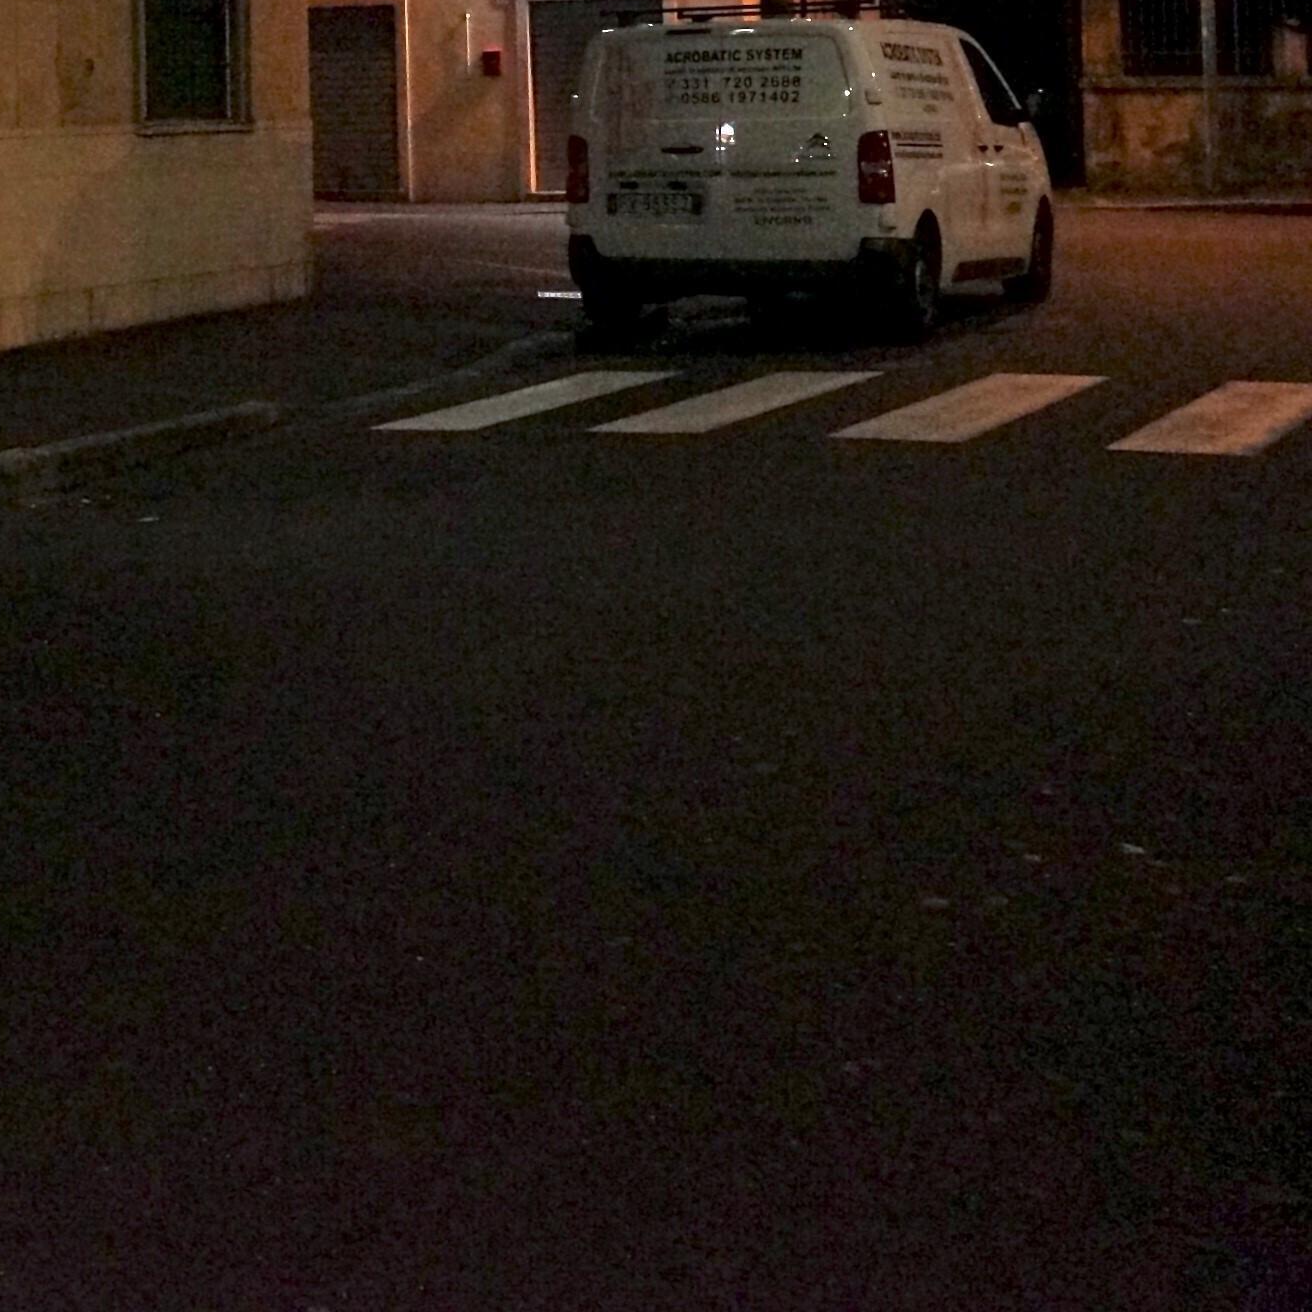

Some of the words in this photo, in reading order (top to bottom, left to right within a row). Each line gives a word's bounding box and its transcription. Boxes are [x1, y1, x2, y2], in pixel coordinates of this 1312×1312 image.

[664, 50, 742, 64] ACROBATIC
[746, 48, 803, 61] SYSTEM
[722, 76, 753, 89] 720
[681, 91, 721, 105] 0586
